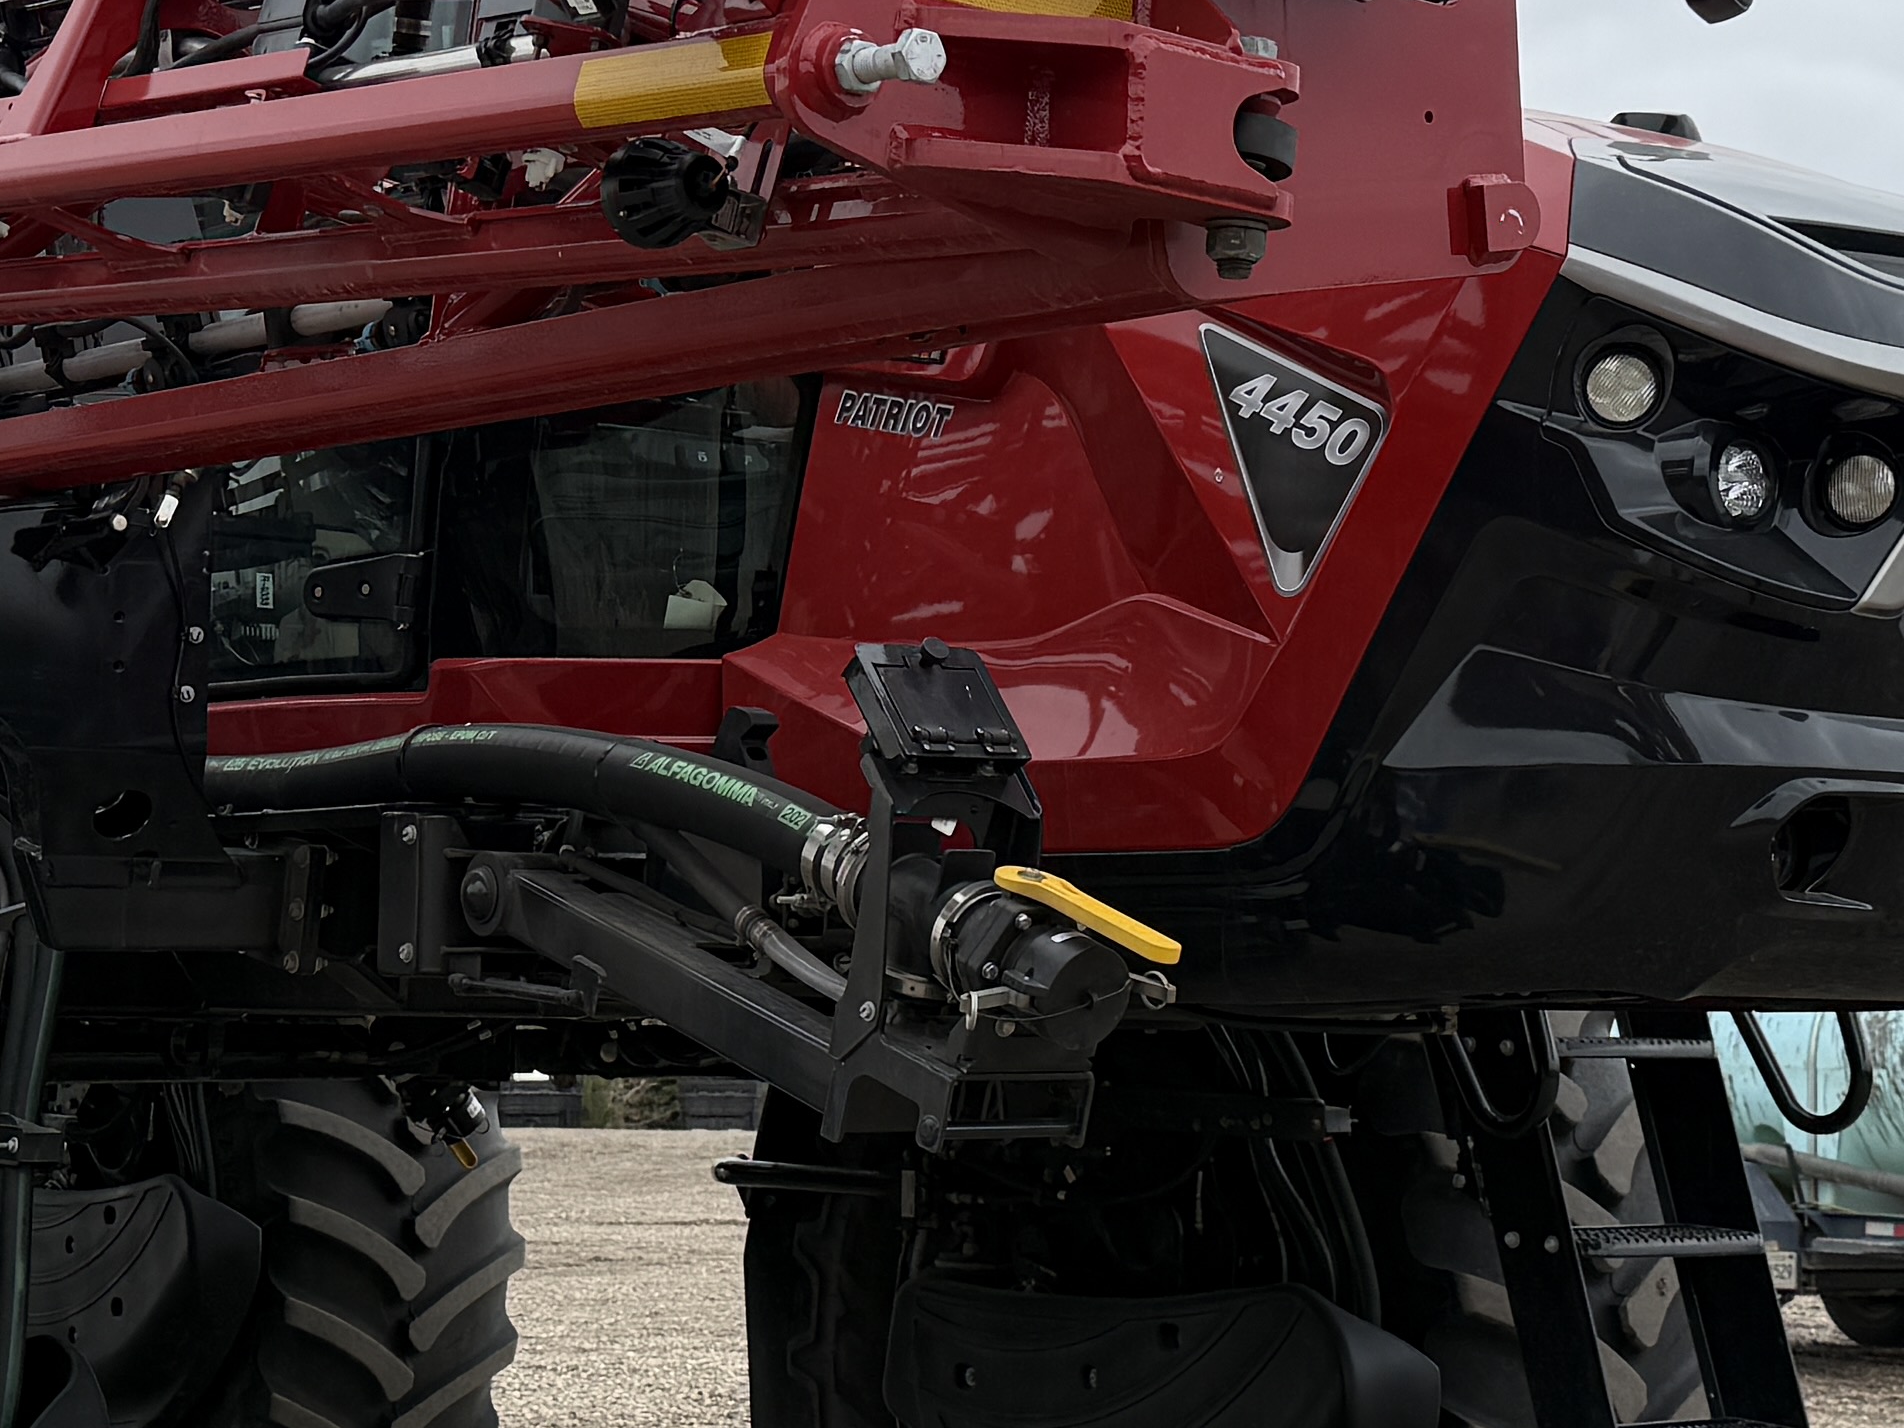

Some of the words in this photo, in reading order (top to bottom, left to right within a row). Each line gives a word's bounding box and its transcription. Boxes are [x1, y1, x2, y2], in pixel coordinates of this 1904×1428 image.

[833, 389, 954, 440] PATRIOT
[1228, 372, 1374, 467] 4450
[645, 752, 759, 808] ALFAGOMMA
[781, 806, 808, 829] 202
